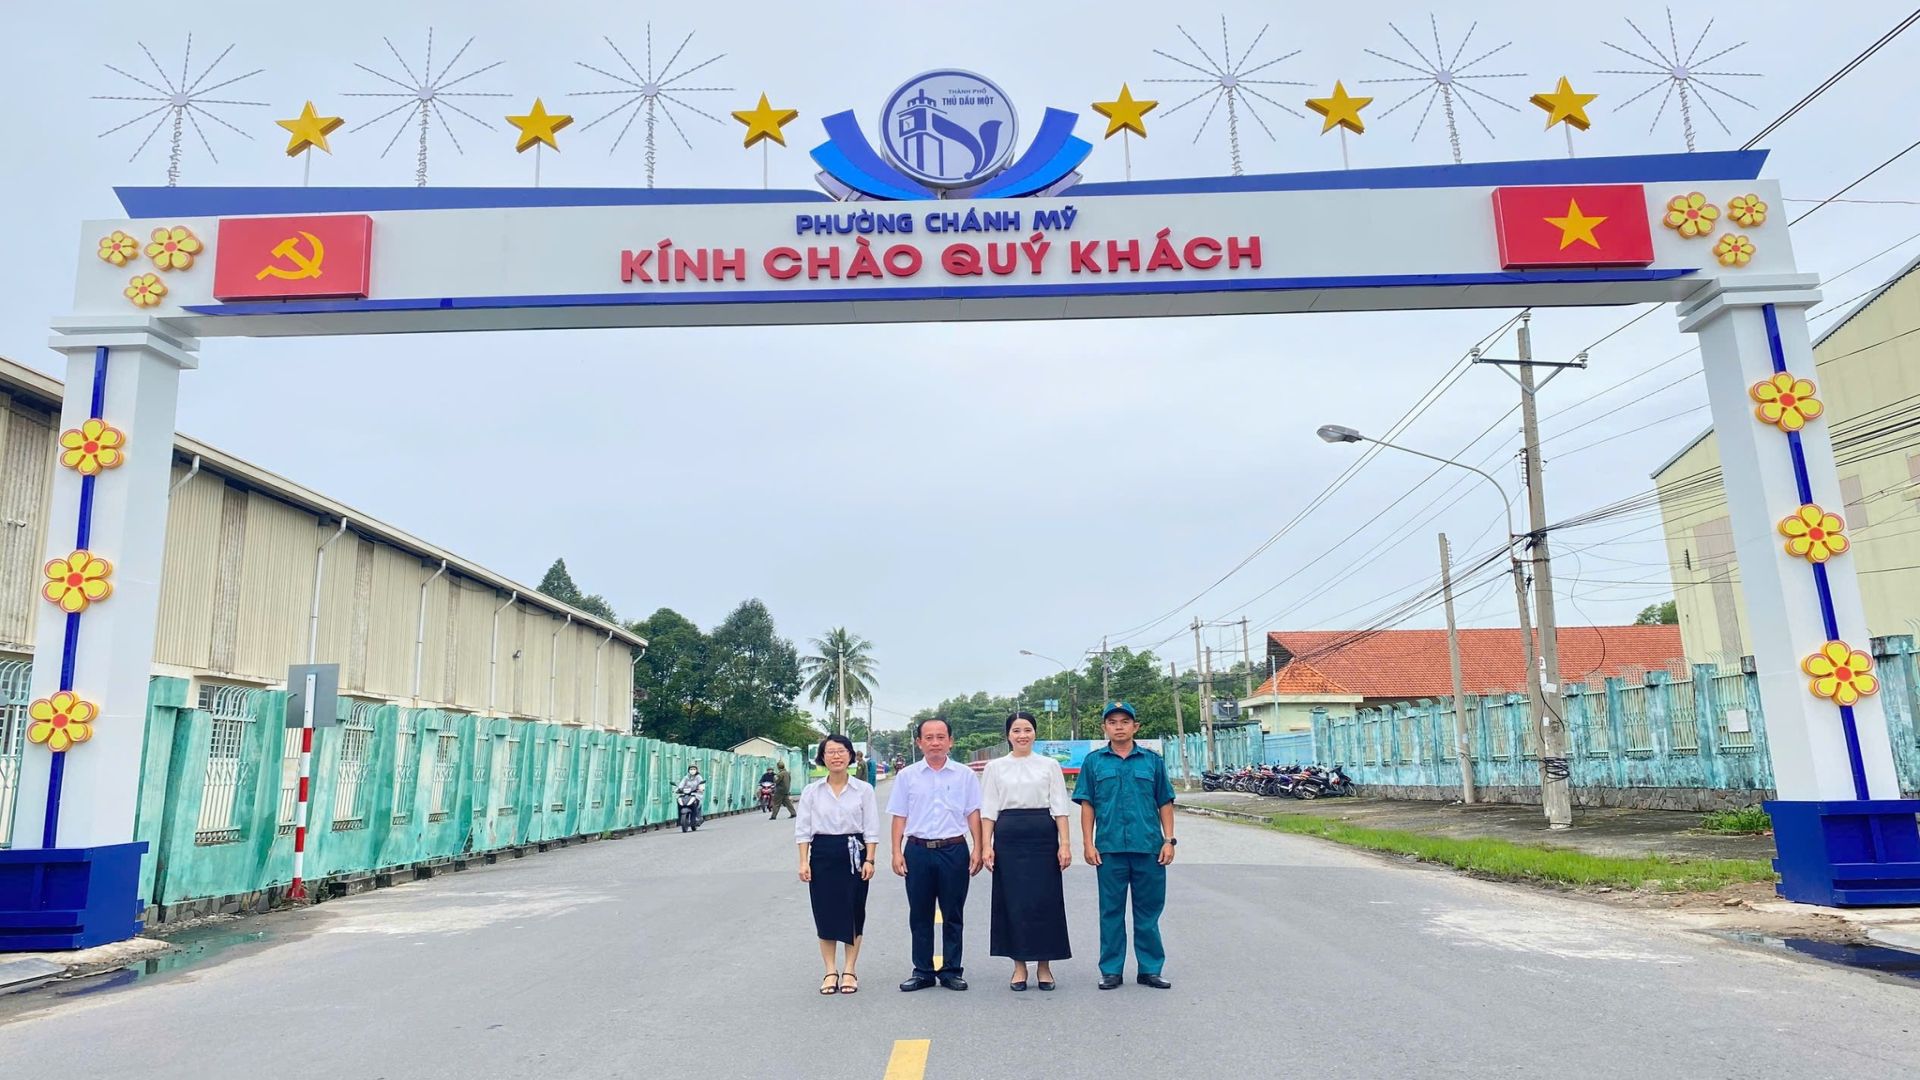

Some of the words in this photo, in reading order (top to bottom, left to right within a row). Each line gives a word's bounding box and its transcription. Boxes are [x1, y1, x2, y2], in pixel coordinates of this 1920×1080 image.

[942, 95, 957, 106] THỦ
[977, 95, 994, 107] MỘT
[796, 209, 913, 235] PHƯỜNG
[925, 207, 1021, 232] CHÁNH
[1033, 205, 1078, 231] MỸ
[621, 238, 746, 283] KÍNH
[763, 235, 923, 280] CHÀO
[941, 231, 1051, 277] QUÝ
[1070, 227, 1262, 274] KHÁCH
